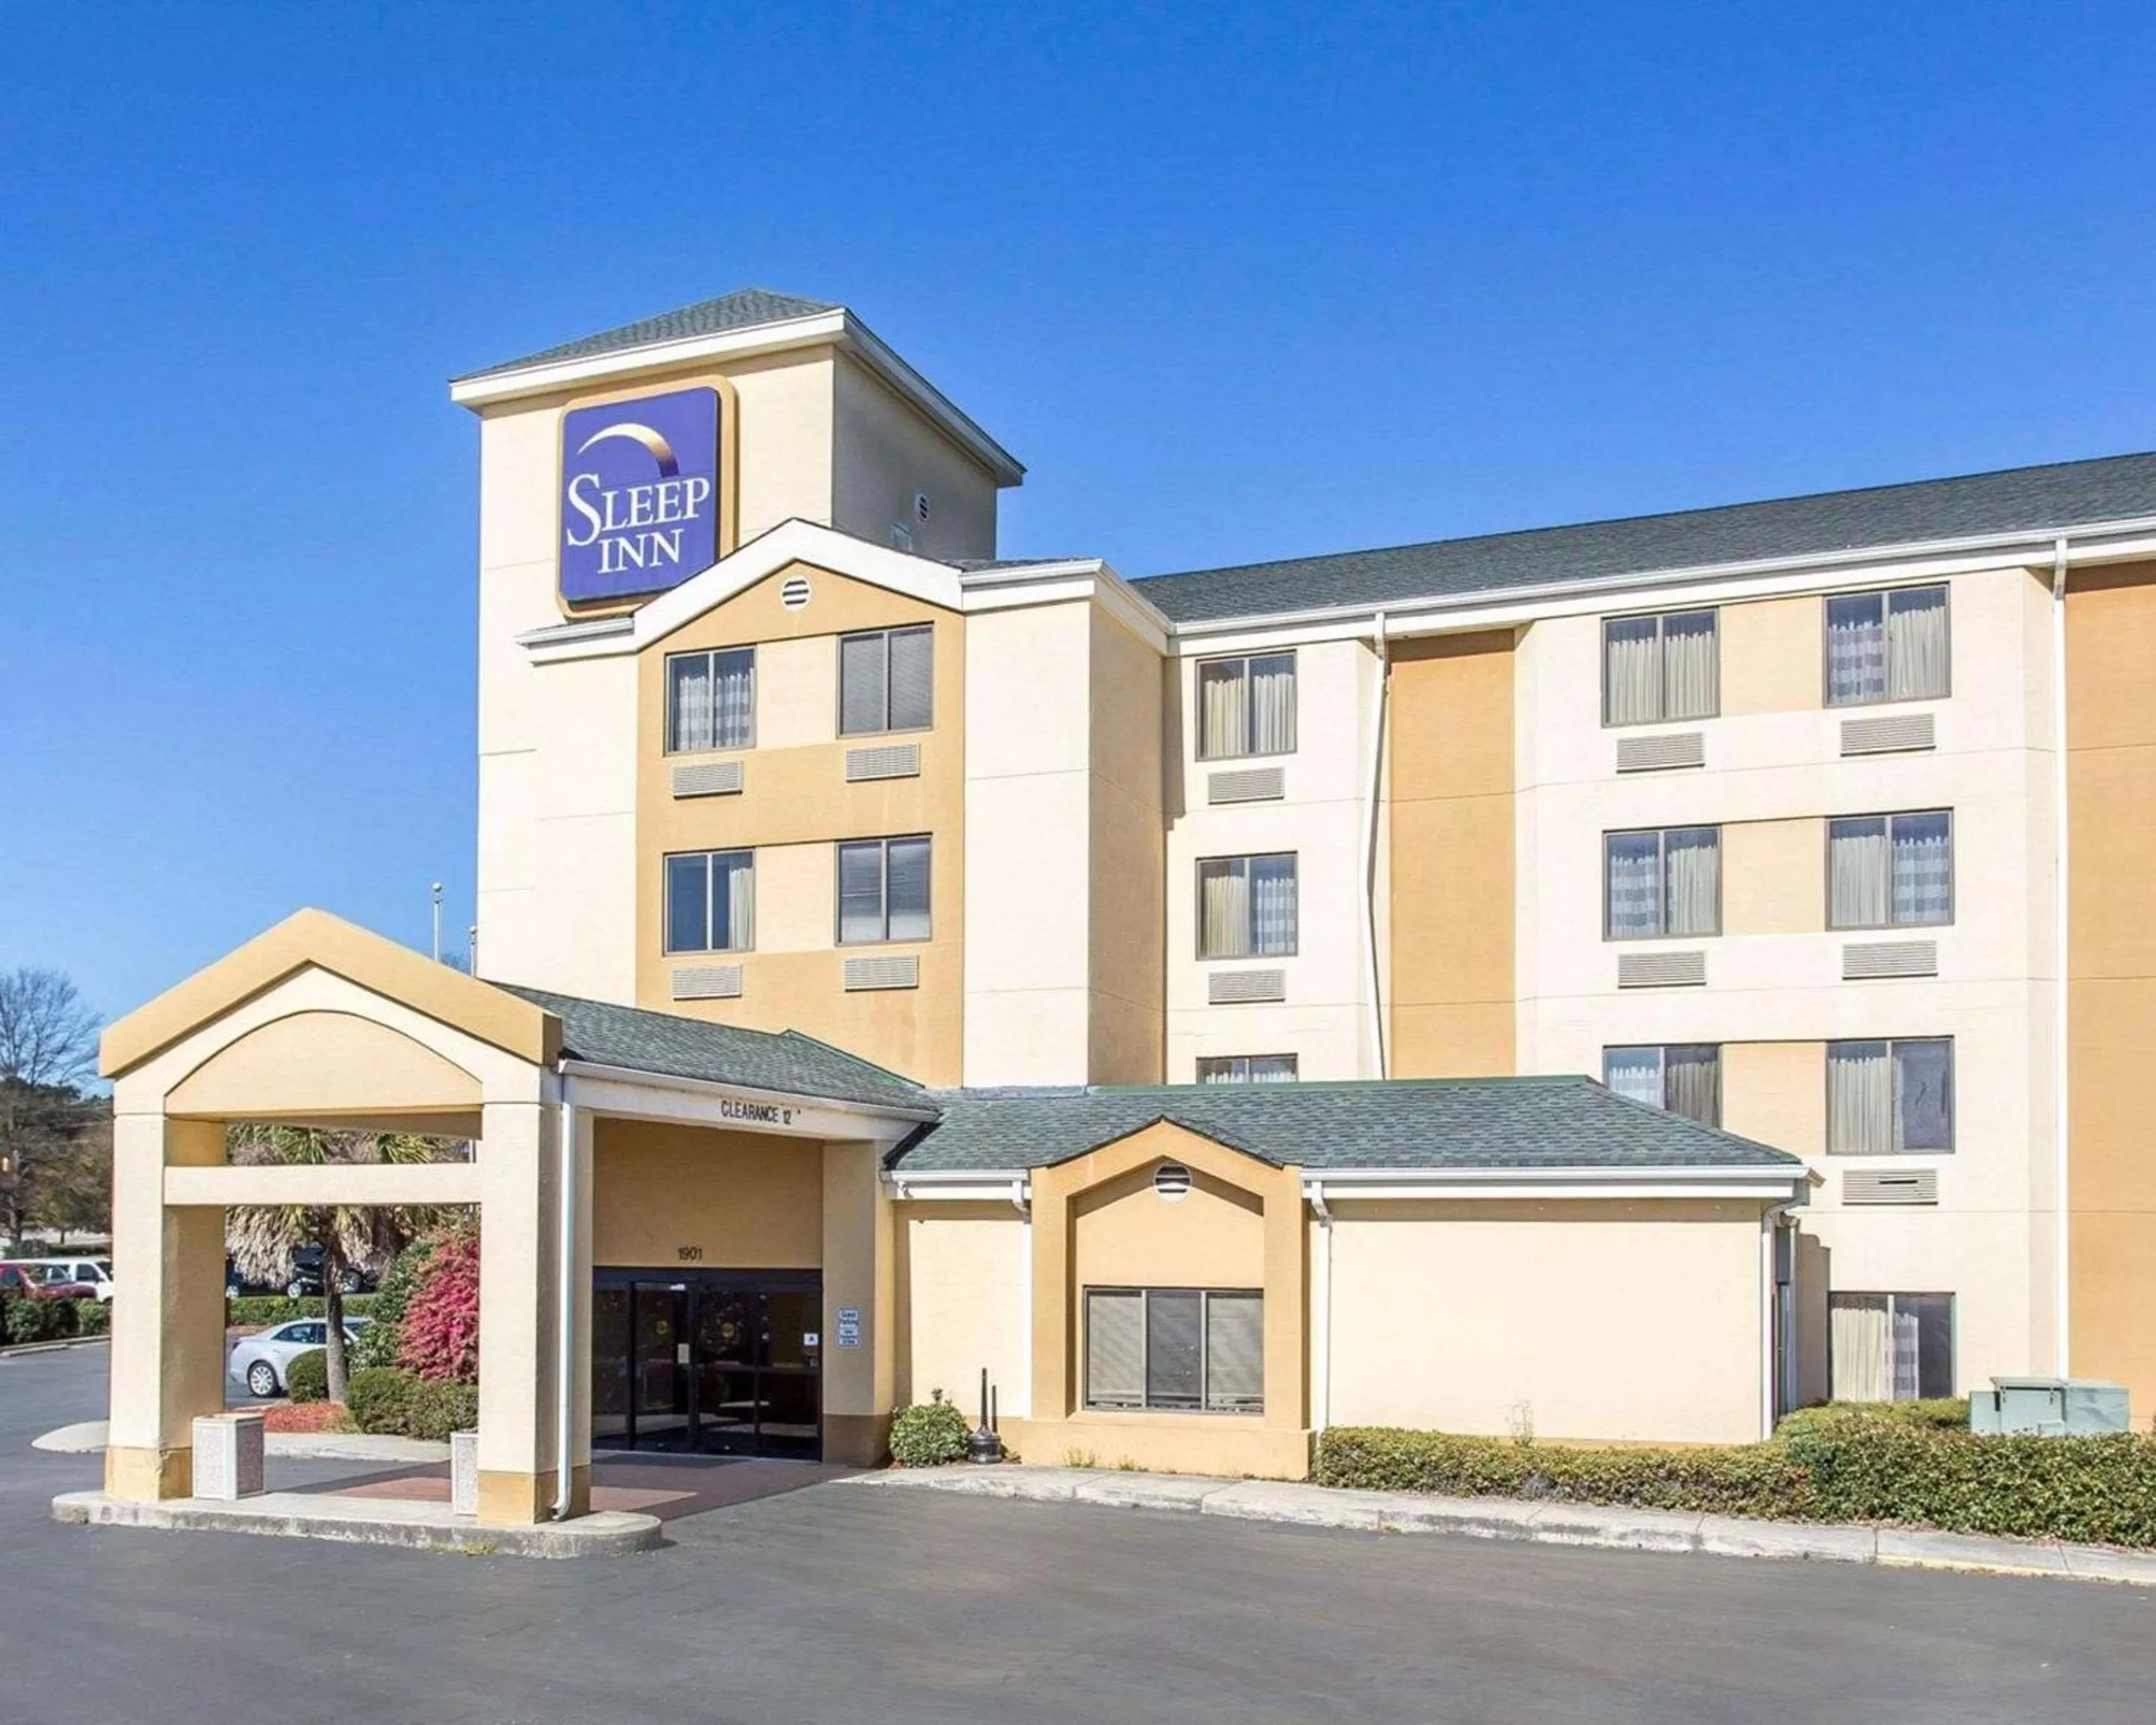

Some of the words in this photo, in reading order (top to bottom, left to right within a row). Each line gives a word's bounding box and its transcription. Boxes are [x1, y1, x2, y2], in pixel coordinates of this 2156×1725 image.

[567, 473, 710, 547] SLEEP
[597, 529, 684, 574] INN
[721, 1100, 779, 1123] CLEARANCE
[678, 1246, 702, 1261] 1901
